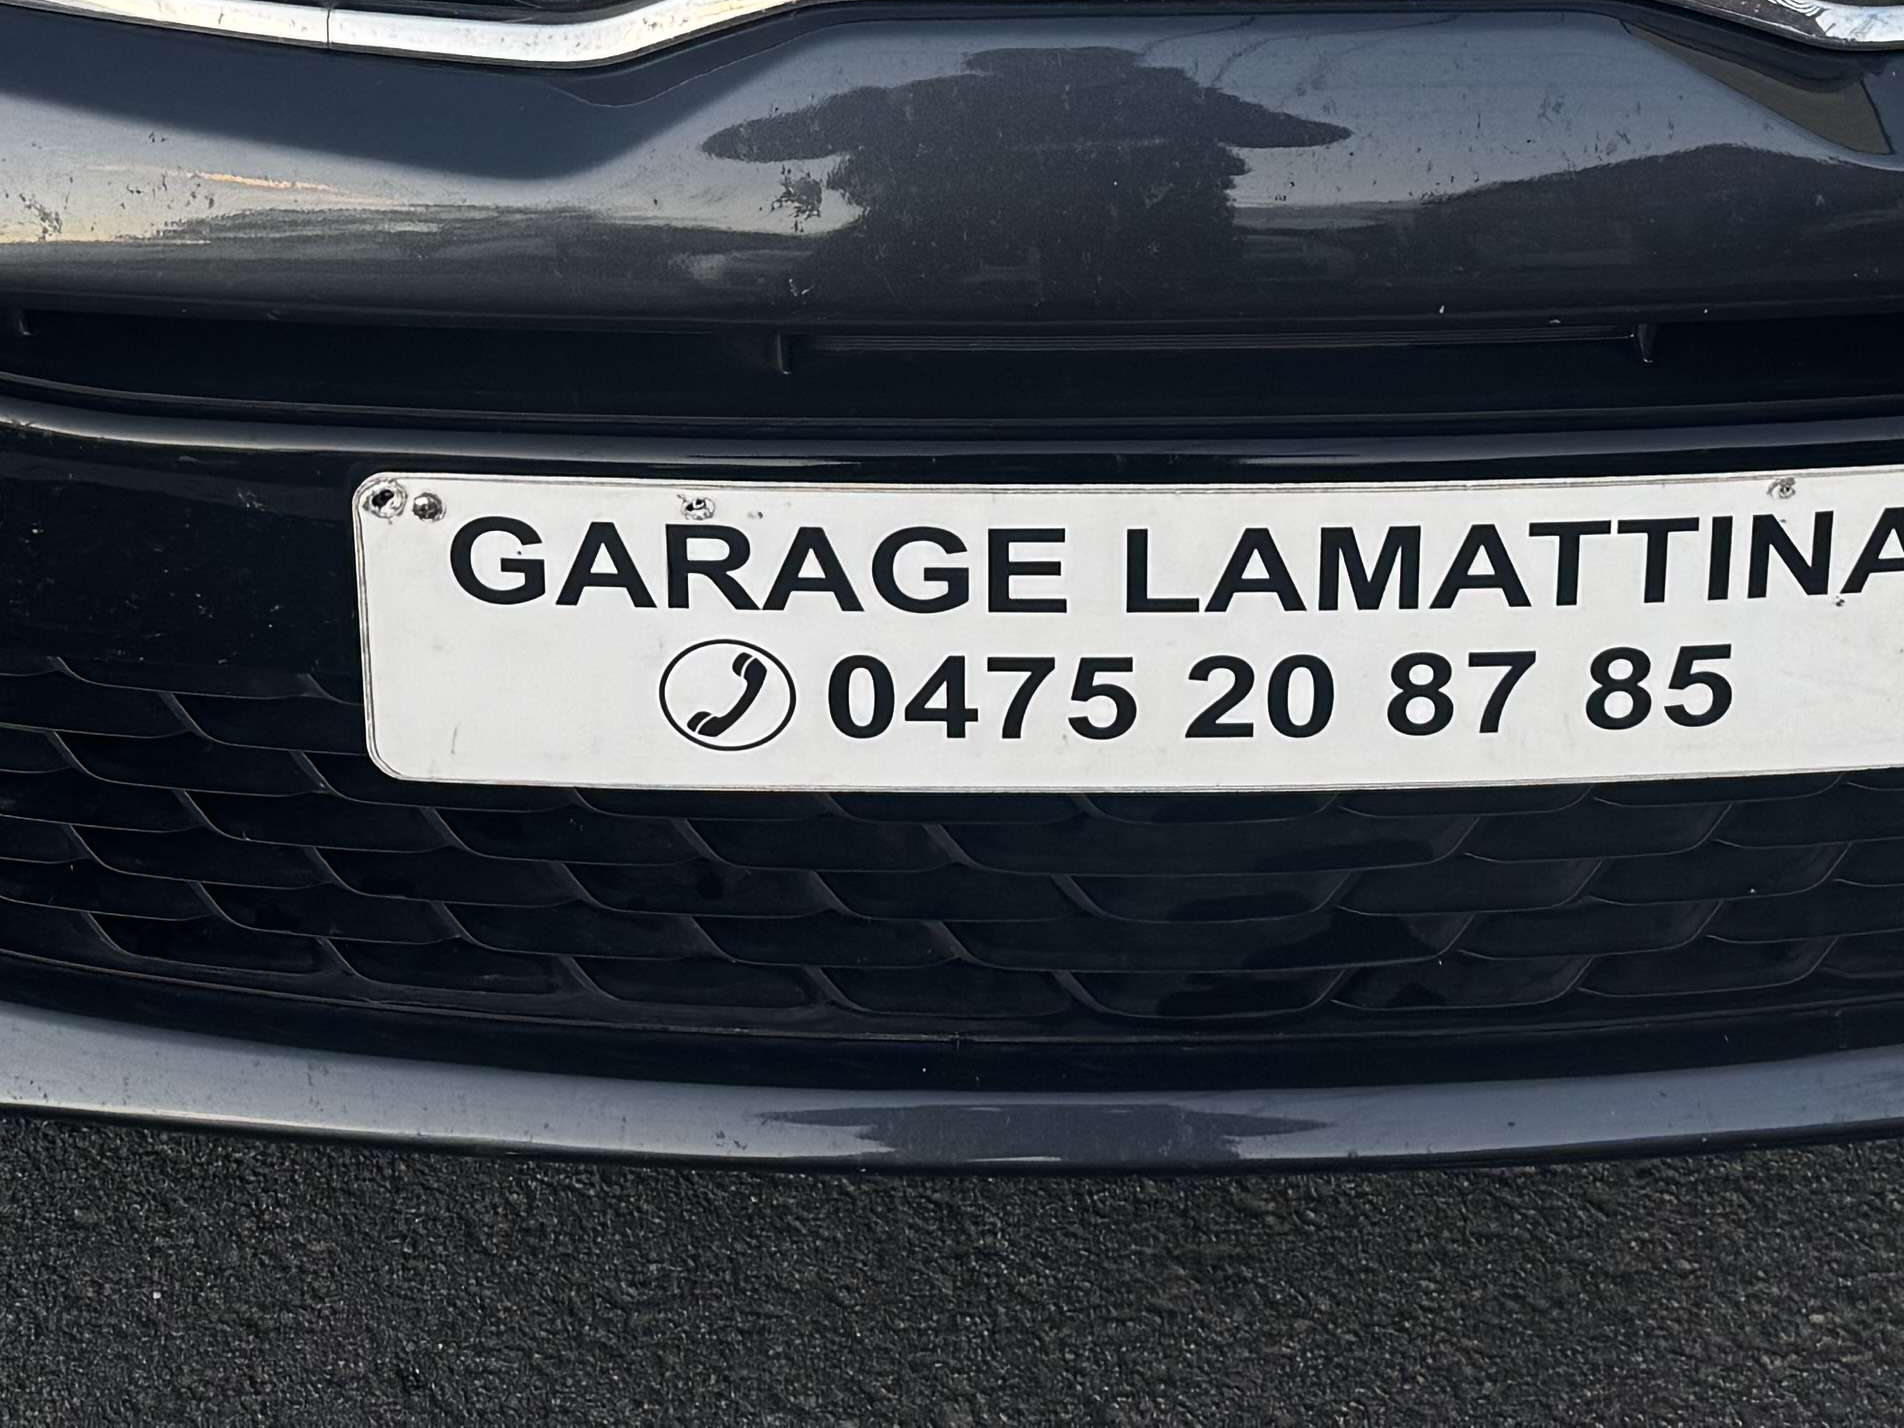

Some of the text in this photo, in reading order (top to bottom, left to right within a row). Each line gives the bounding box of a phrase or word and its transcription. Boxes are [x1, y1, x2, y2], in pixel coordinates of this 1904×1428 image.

[451, 516, 1069, 614] GARAGE
[829, 643, 1734, 740] 0475 20 87 85
